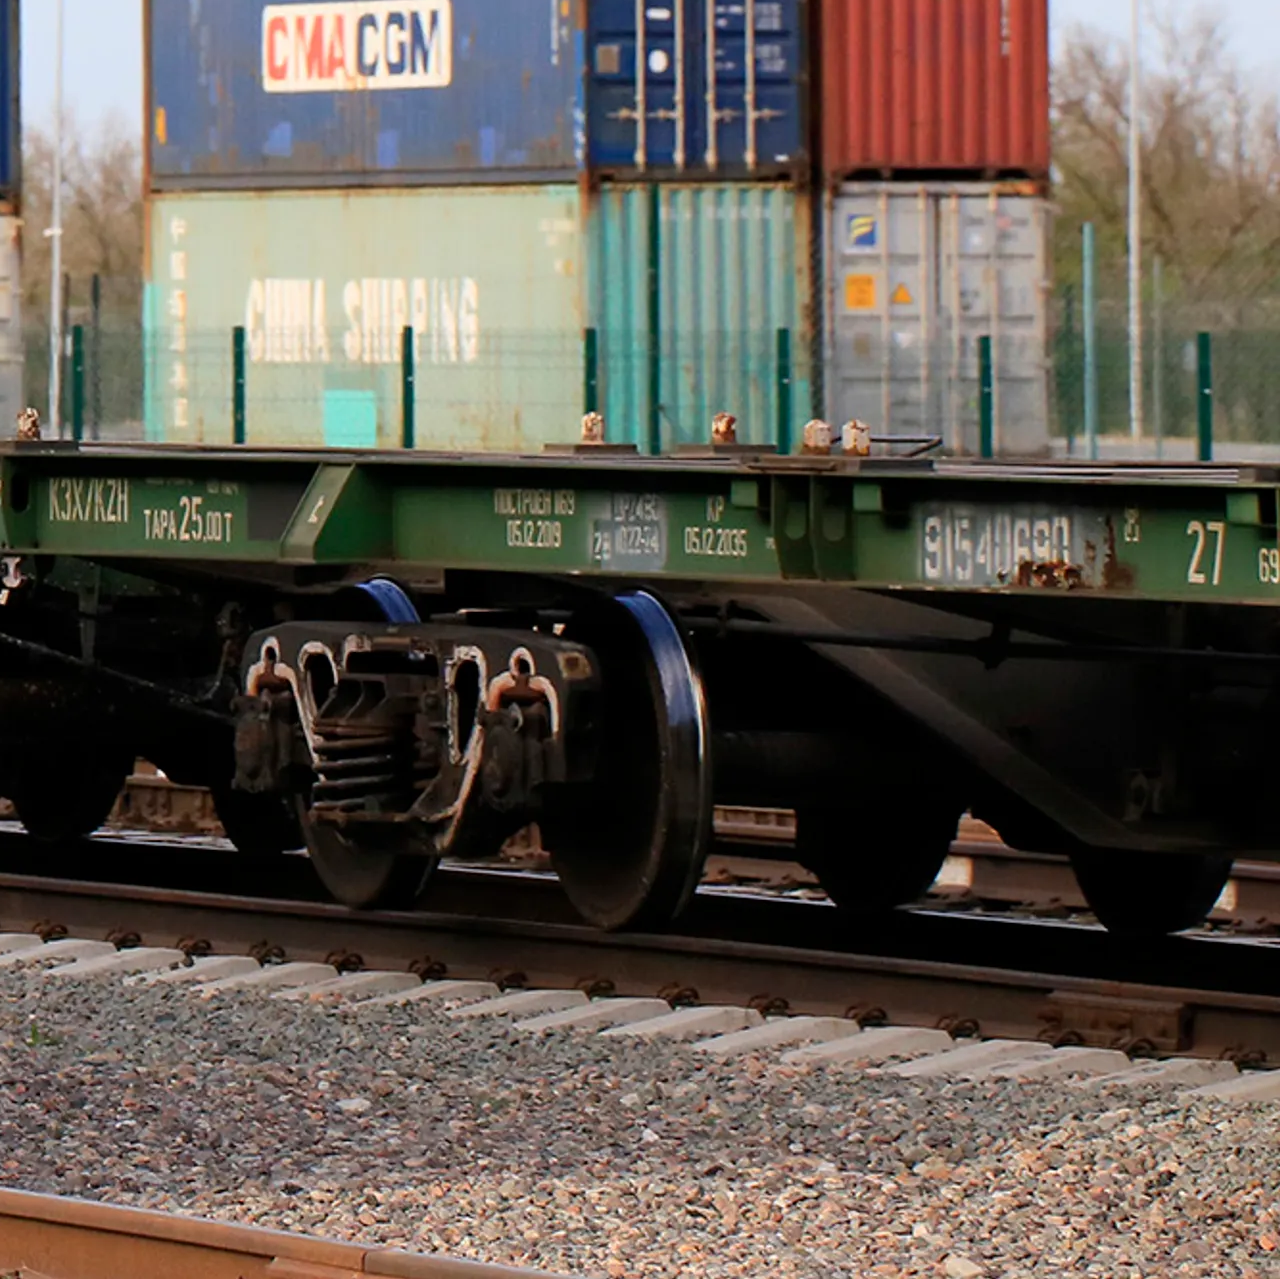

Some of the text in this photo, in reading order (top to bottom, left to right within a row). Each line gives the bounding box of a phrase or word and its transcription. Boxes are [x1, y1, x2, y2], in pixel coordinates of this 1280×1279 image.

[267, 10, 439, 81] CMA CGM
[246, 278, 331, 363] CHINA
[344, 277, 479, 364] SHIPPING
[1186, 521, 1225, 586] 27
